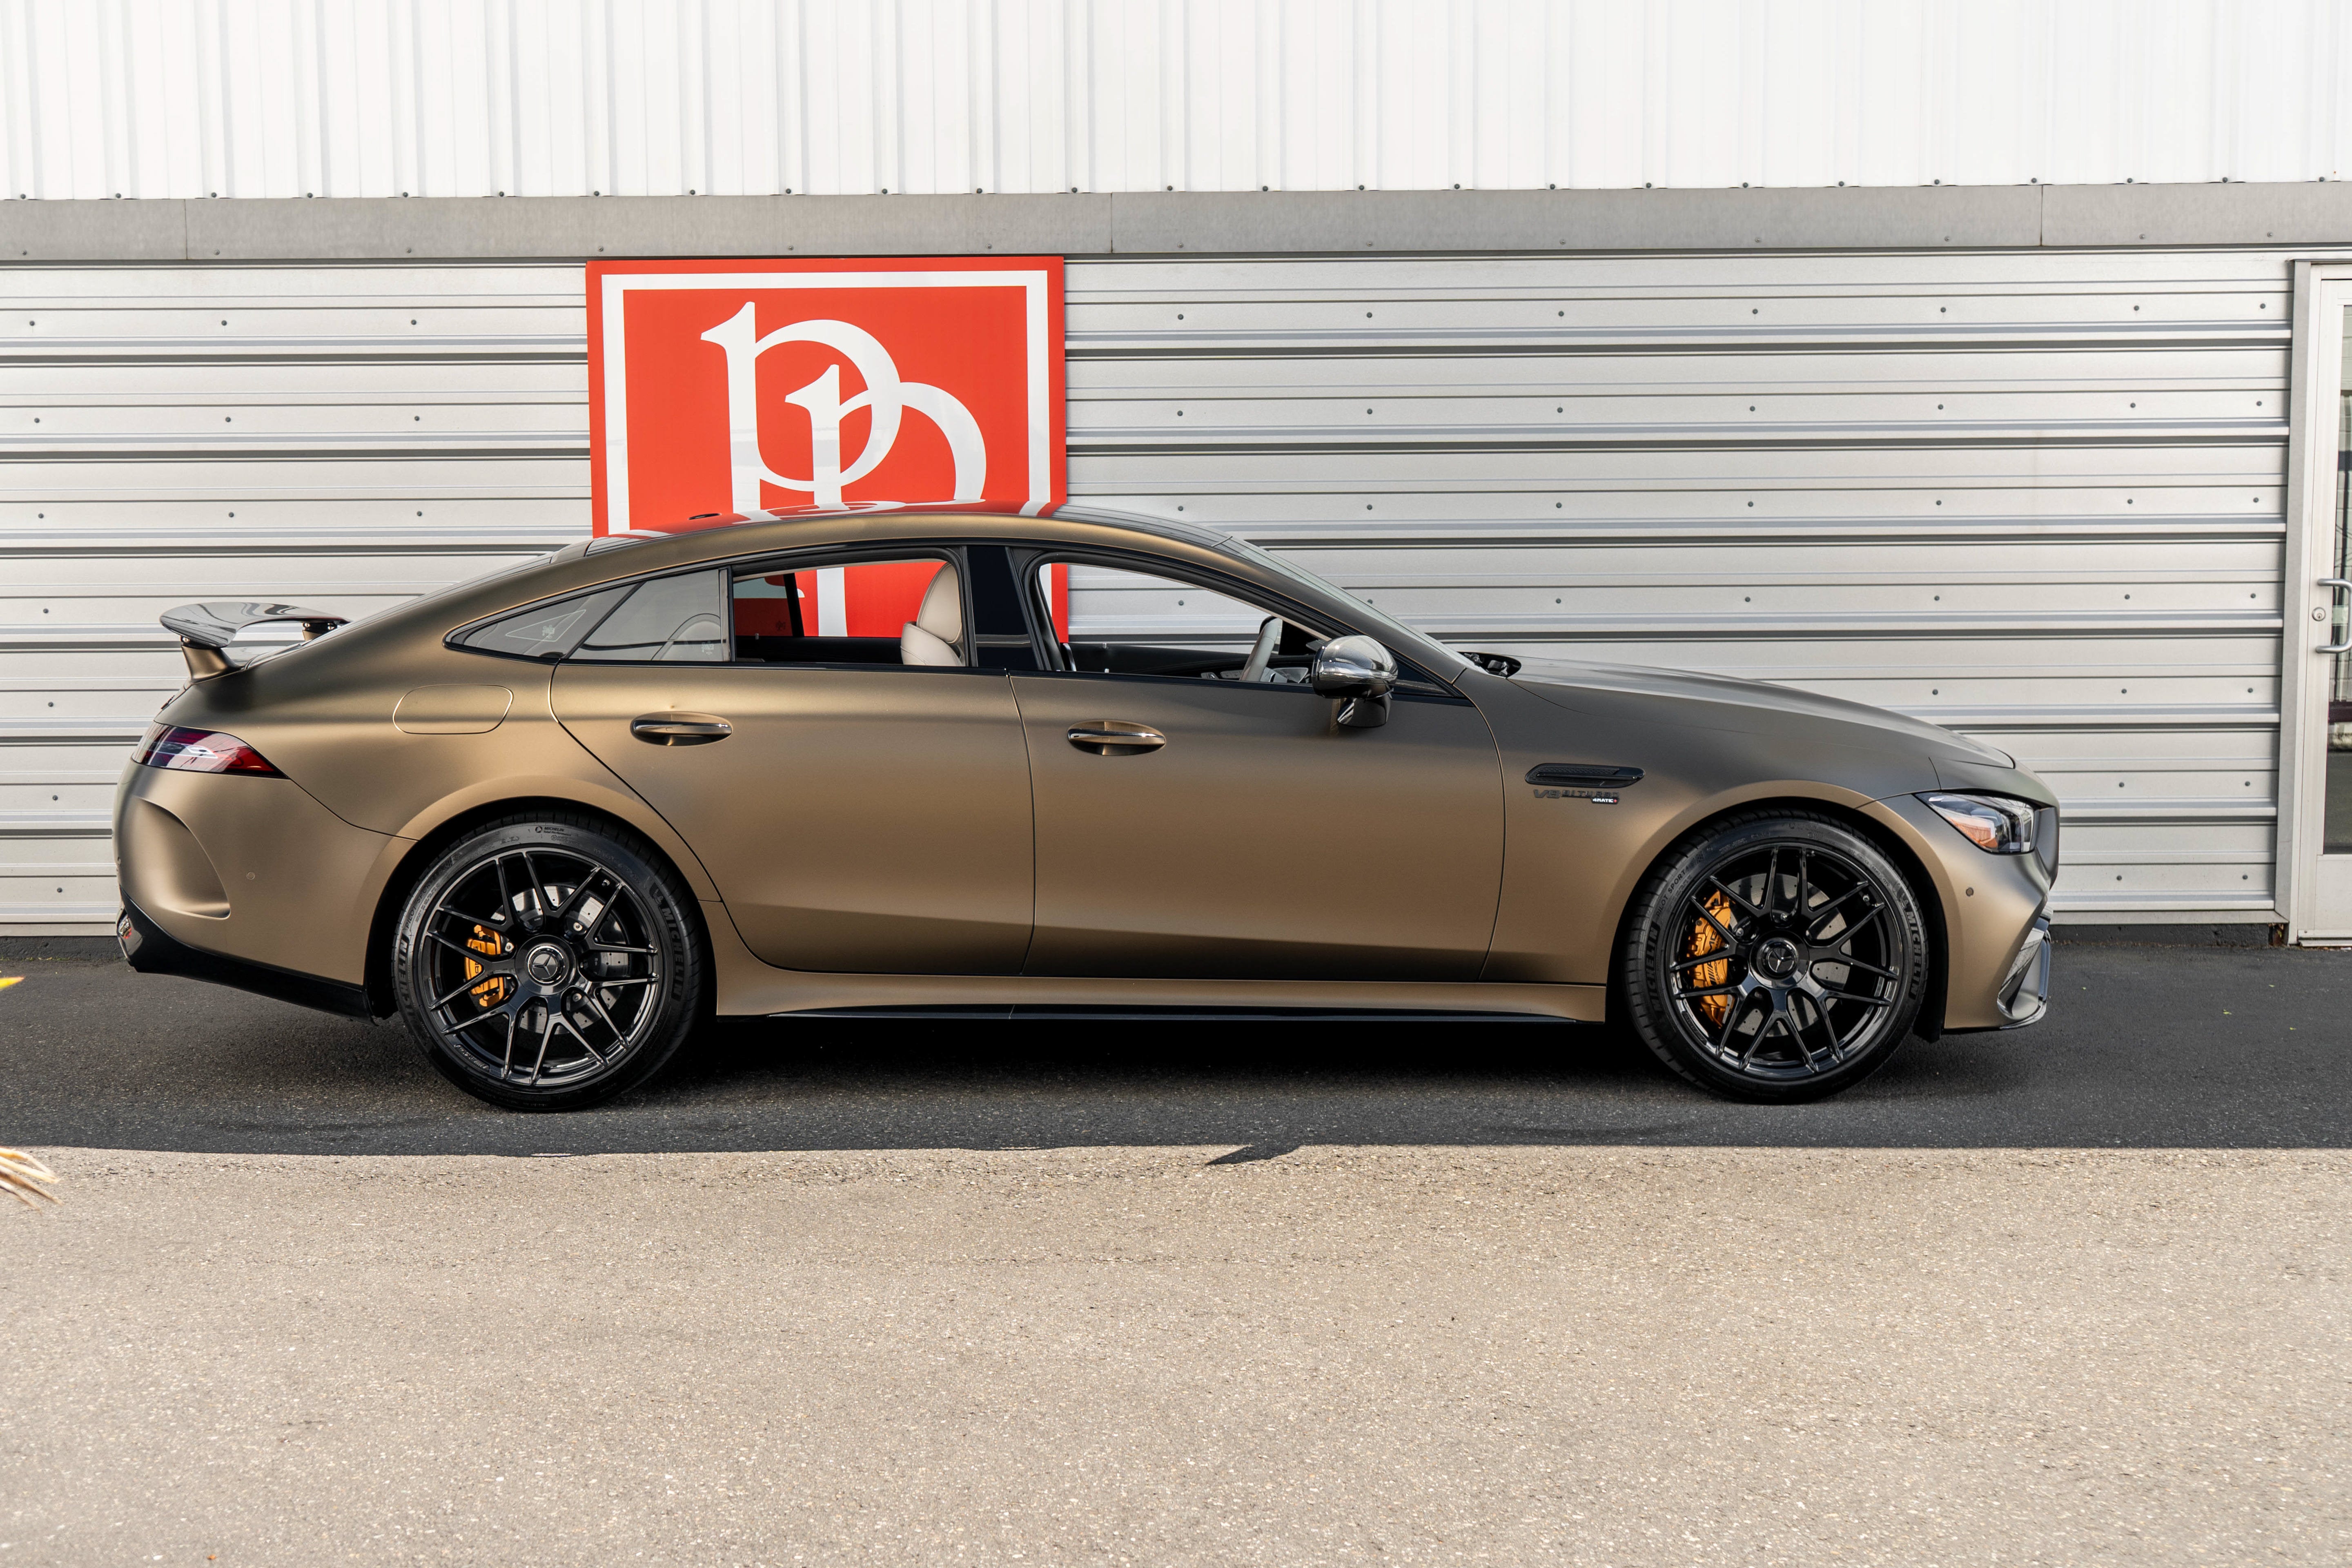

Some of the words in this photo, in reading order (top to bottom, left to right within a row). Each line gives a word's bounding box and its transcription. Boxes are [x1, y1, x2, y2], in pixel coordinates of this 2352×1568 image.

[1533, 789, 1560, 798] V8
[406, 906, 416, 929] PILOT
[1656, 894, 1668, 917] PILOT
[1668, 869, 1686, 894] SPORT
[662, 908, 685, 997] MICHELIN
[1646, 926, 1662, 1012] MICHELIN
[1906, 911, 1922, 997] MICHELIN
